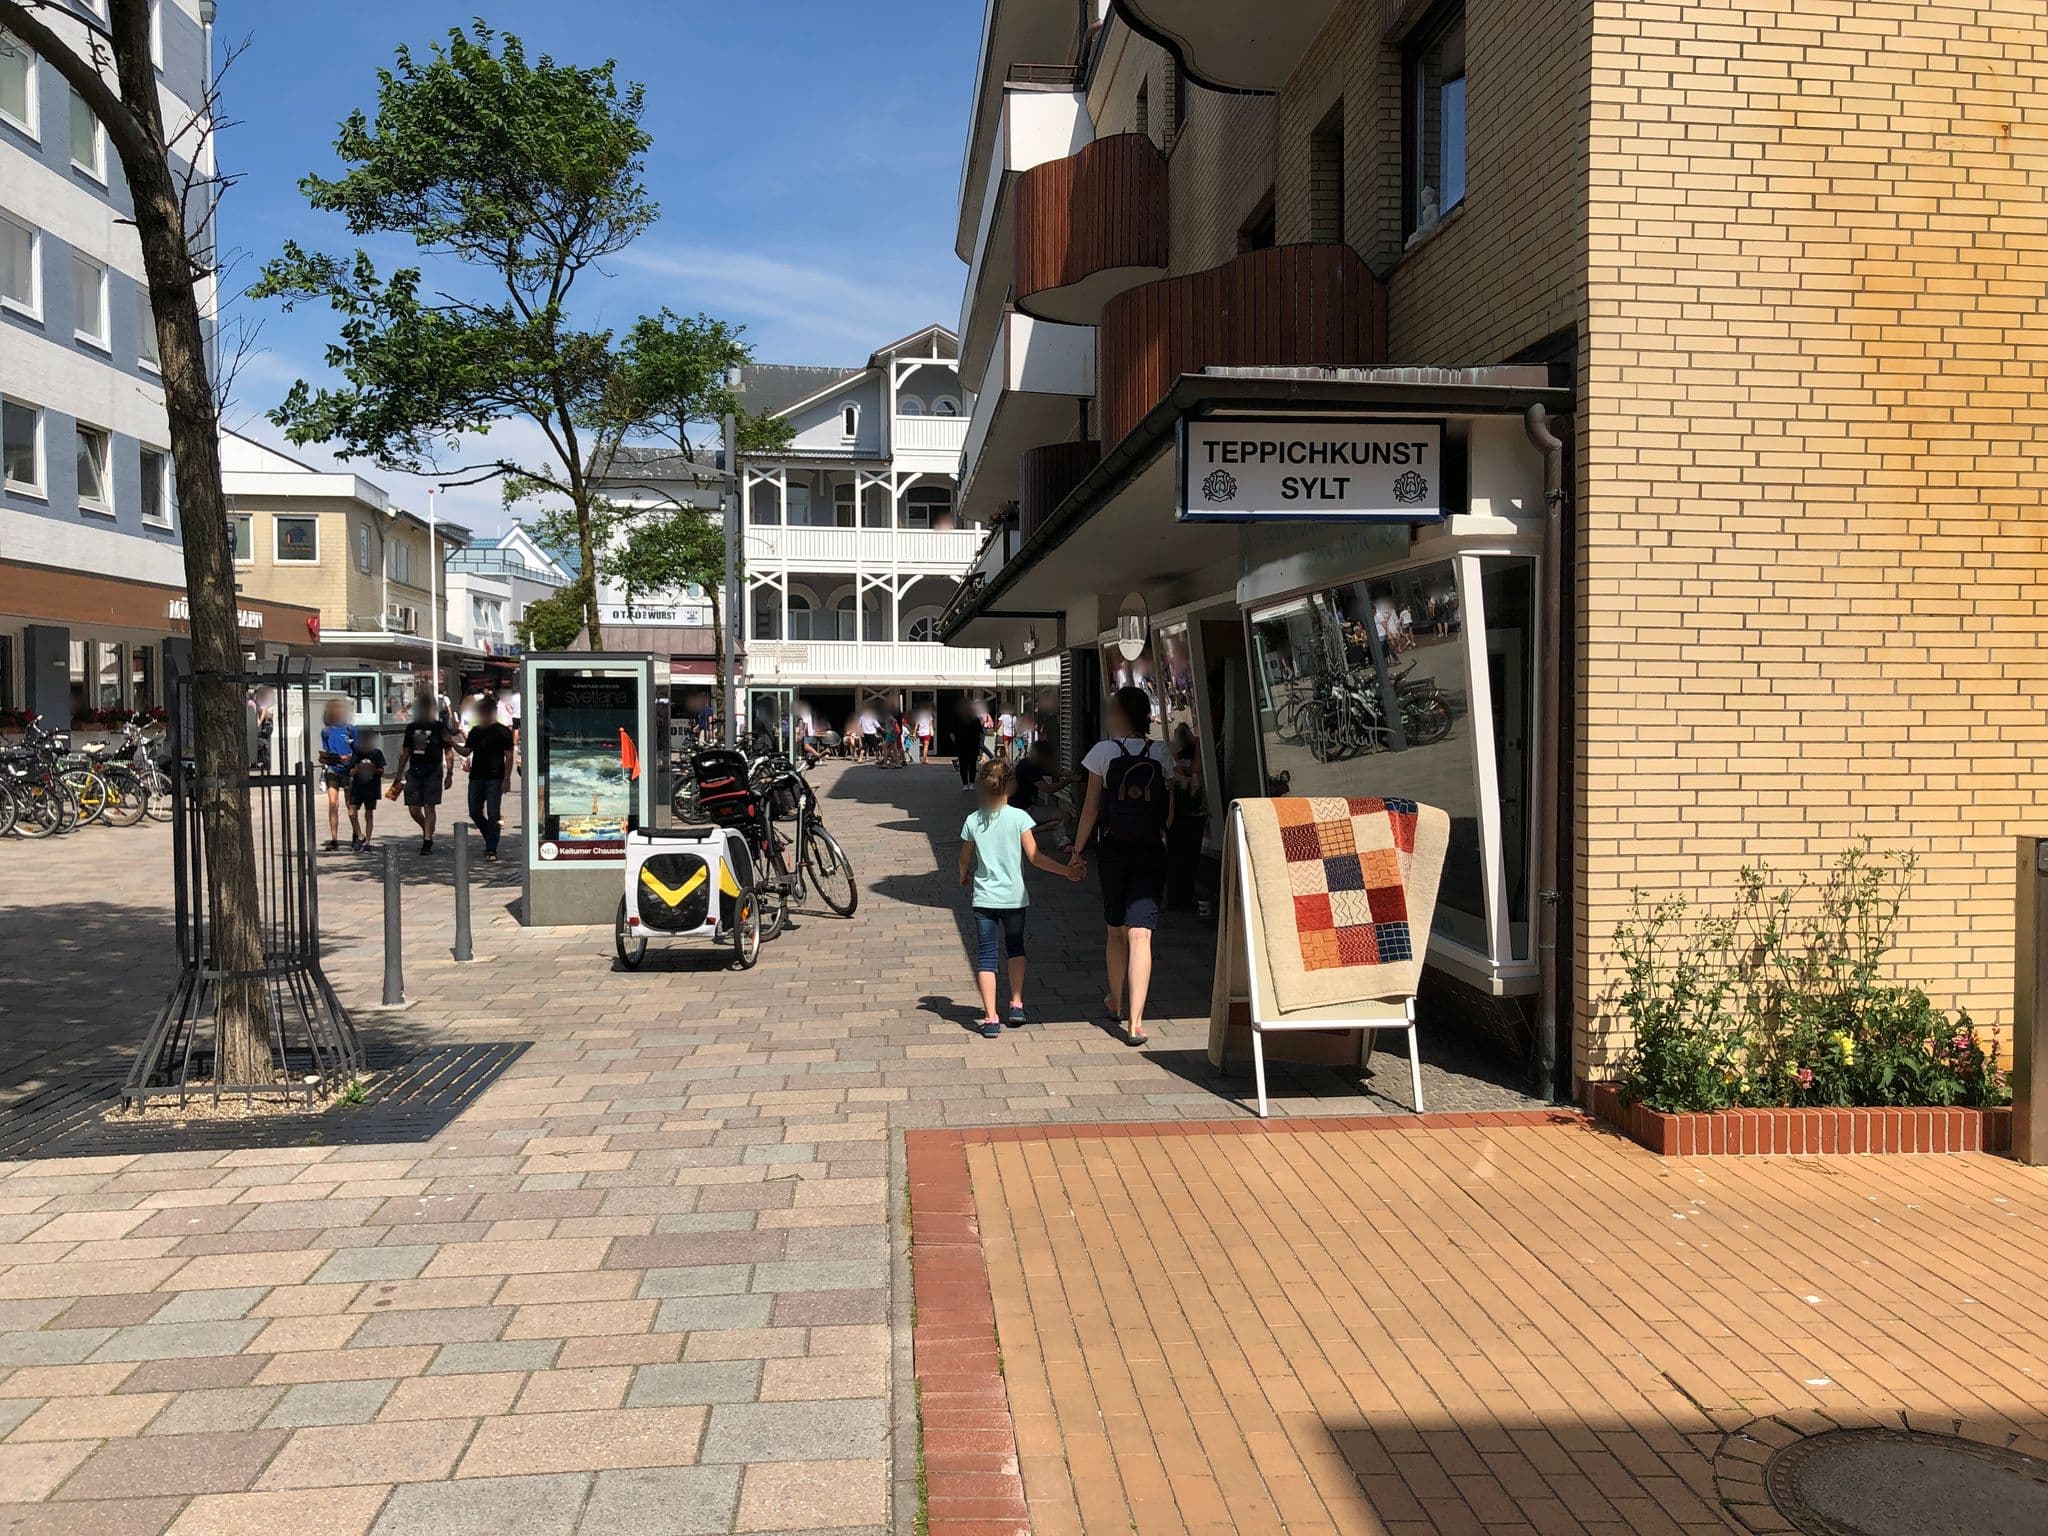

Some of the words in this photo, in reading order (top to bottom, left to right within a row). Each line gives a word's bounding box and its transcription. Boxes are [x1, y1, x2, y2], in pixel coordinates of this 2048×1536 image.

[1202, 440, 1429, 465] TEPPICHKUNST
[1280, 477, 1351, 500] SYLT
[612, 610, 642, 619] OTO
[648, 611, 677, 620] WURST
[559, 847, 592, 855] Keitumer
